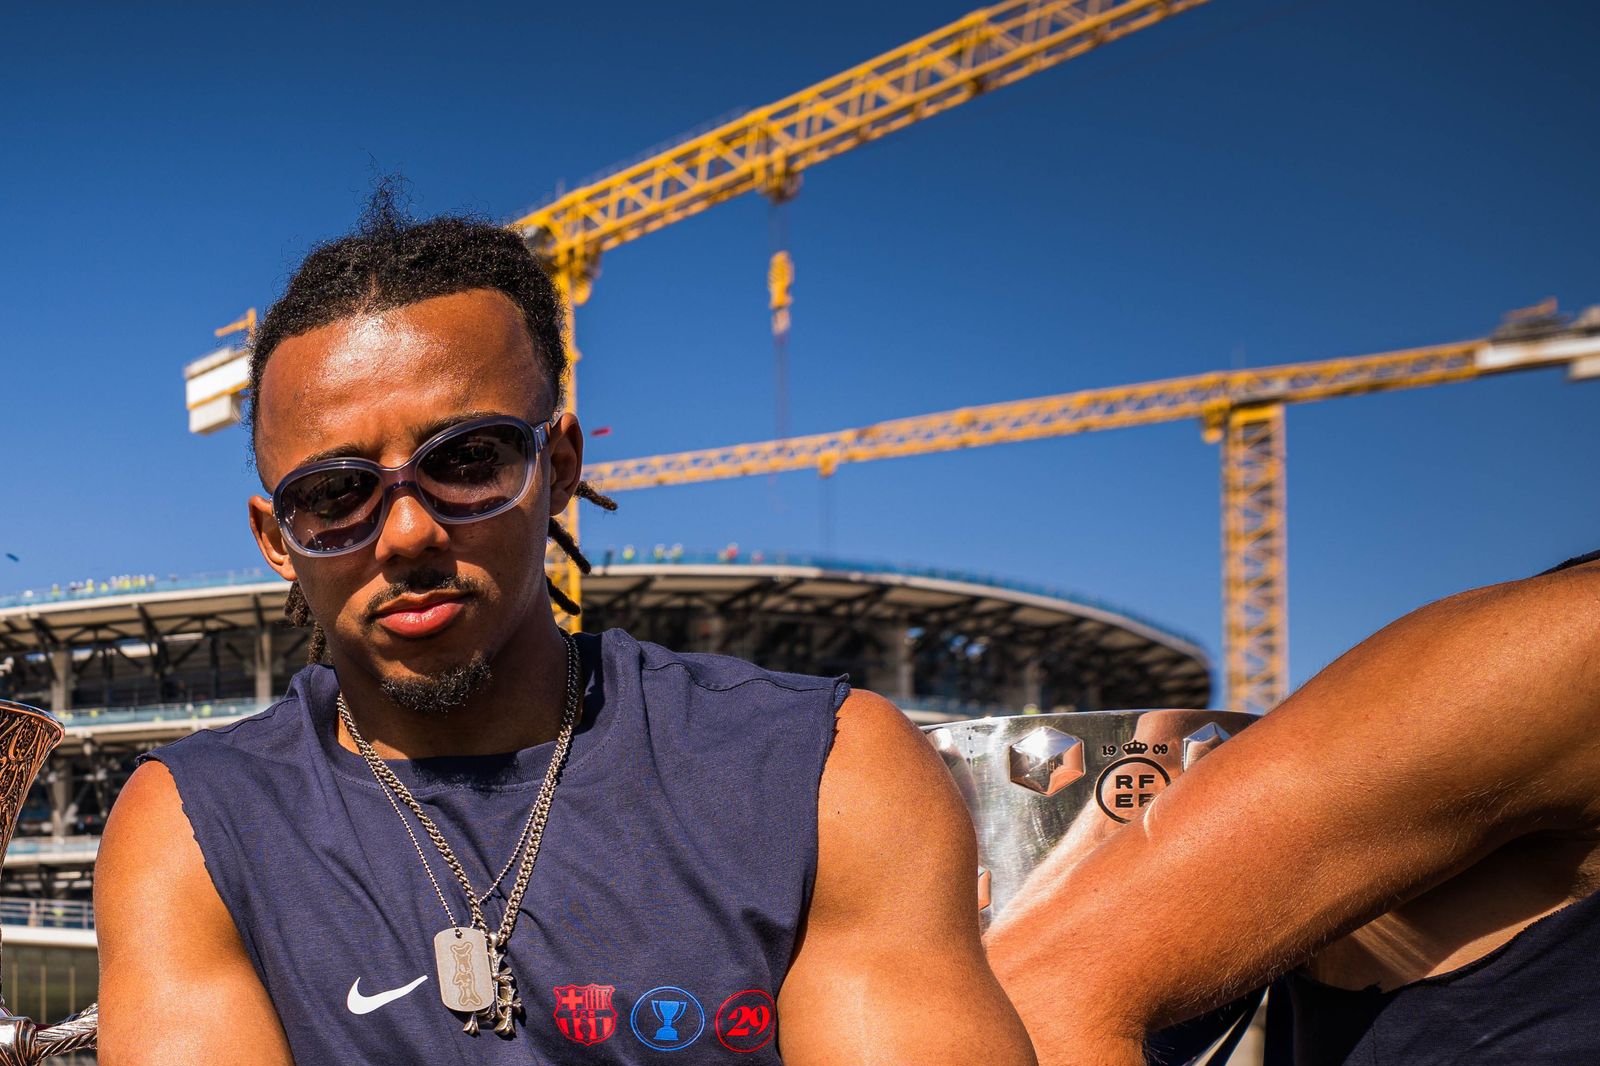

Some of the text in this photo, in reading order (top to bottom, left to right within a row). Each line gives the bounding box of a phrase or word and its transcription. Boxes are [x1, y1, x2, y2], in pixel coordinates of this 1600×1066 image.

[1102, 744, 1169, 756] 19 09
[1115, 775, 1155, 789] RF
[726, 1005, 771, 1037] 29
